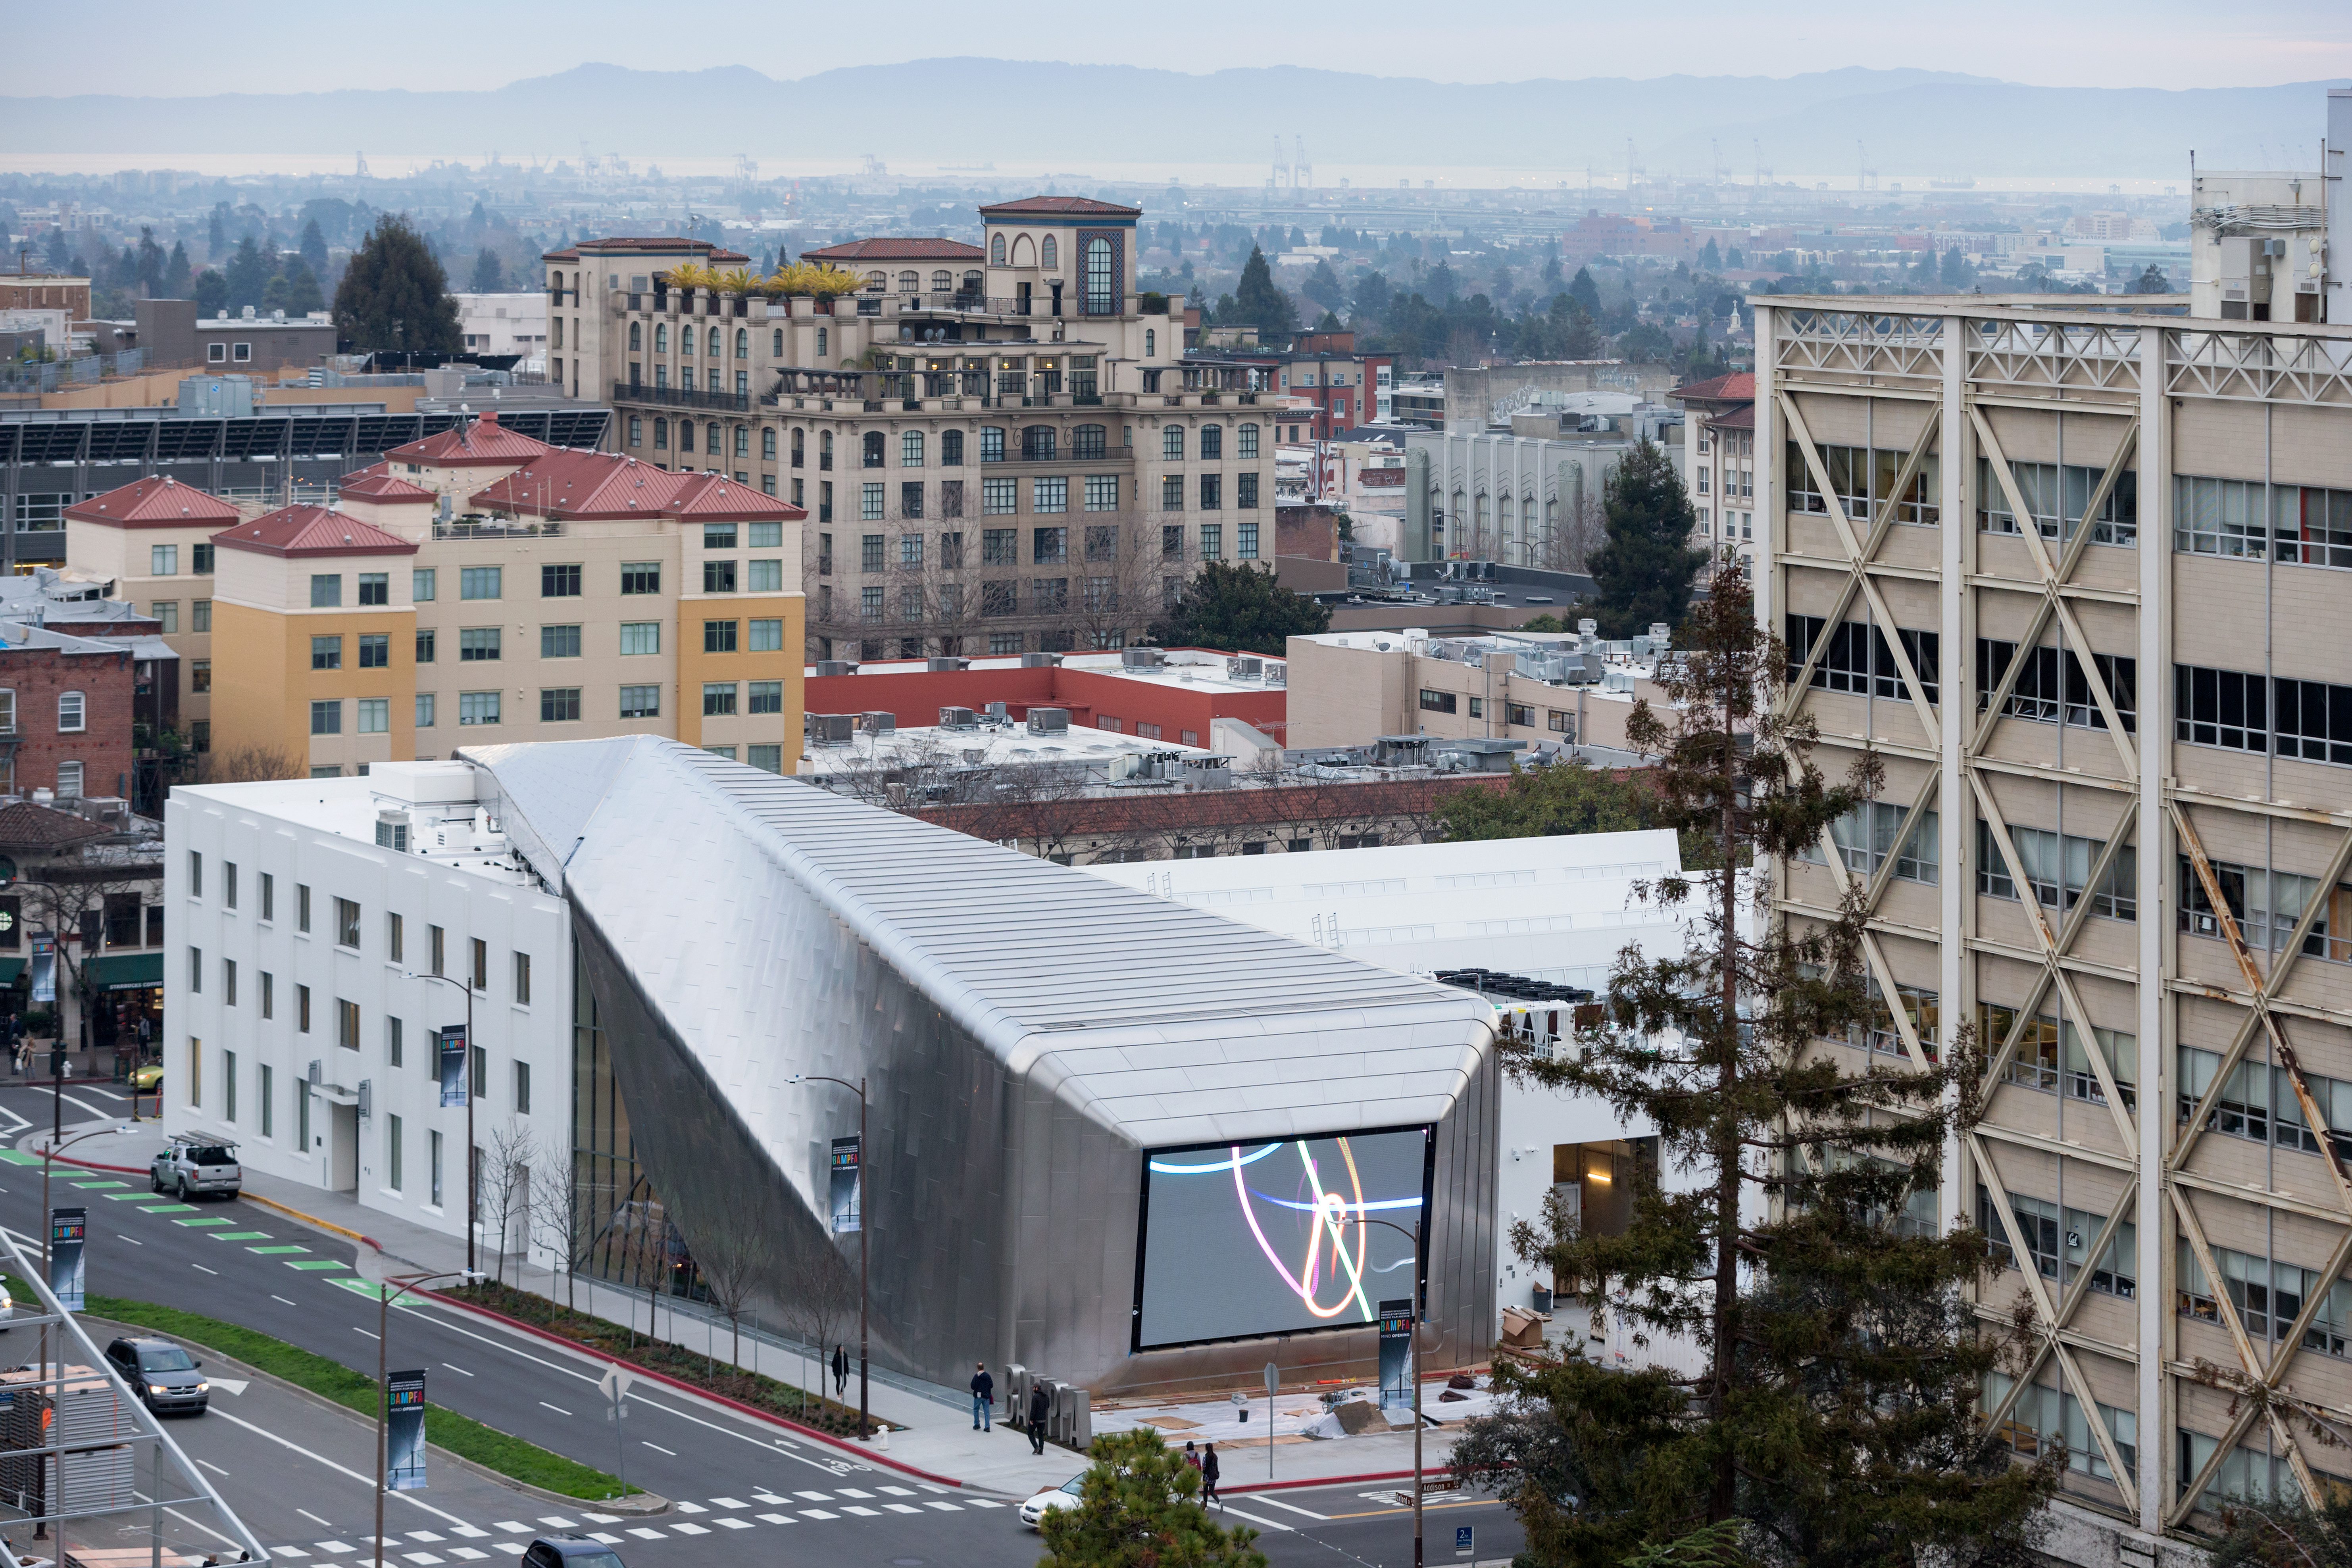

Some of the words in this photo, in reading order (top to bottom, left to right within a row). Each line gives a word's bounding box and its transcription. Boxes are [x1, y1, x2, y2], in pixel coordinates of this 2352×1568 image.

[833, 1153, 858, 1165] BAMPFA
[54, 1226, 83, 1238] BAMPFA
[2068, 1233, 2077, 1246] Cal
[1381, 1319, 1410, 1332] BAMPFA
[390, 1390, 423, 1405] BAMPFA
[1423, 1483, 1444, 1492] Addison
[1396, 1493, 1407, 1505] Oxford
[1460, 1530, 1464, 1538] 2
